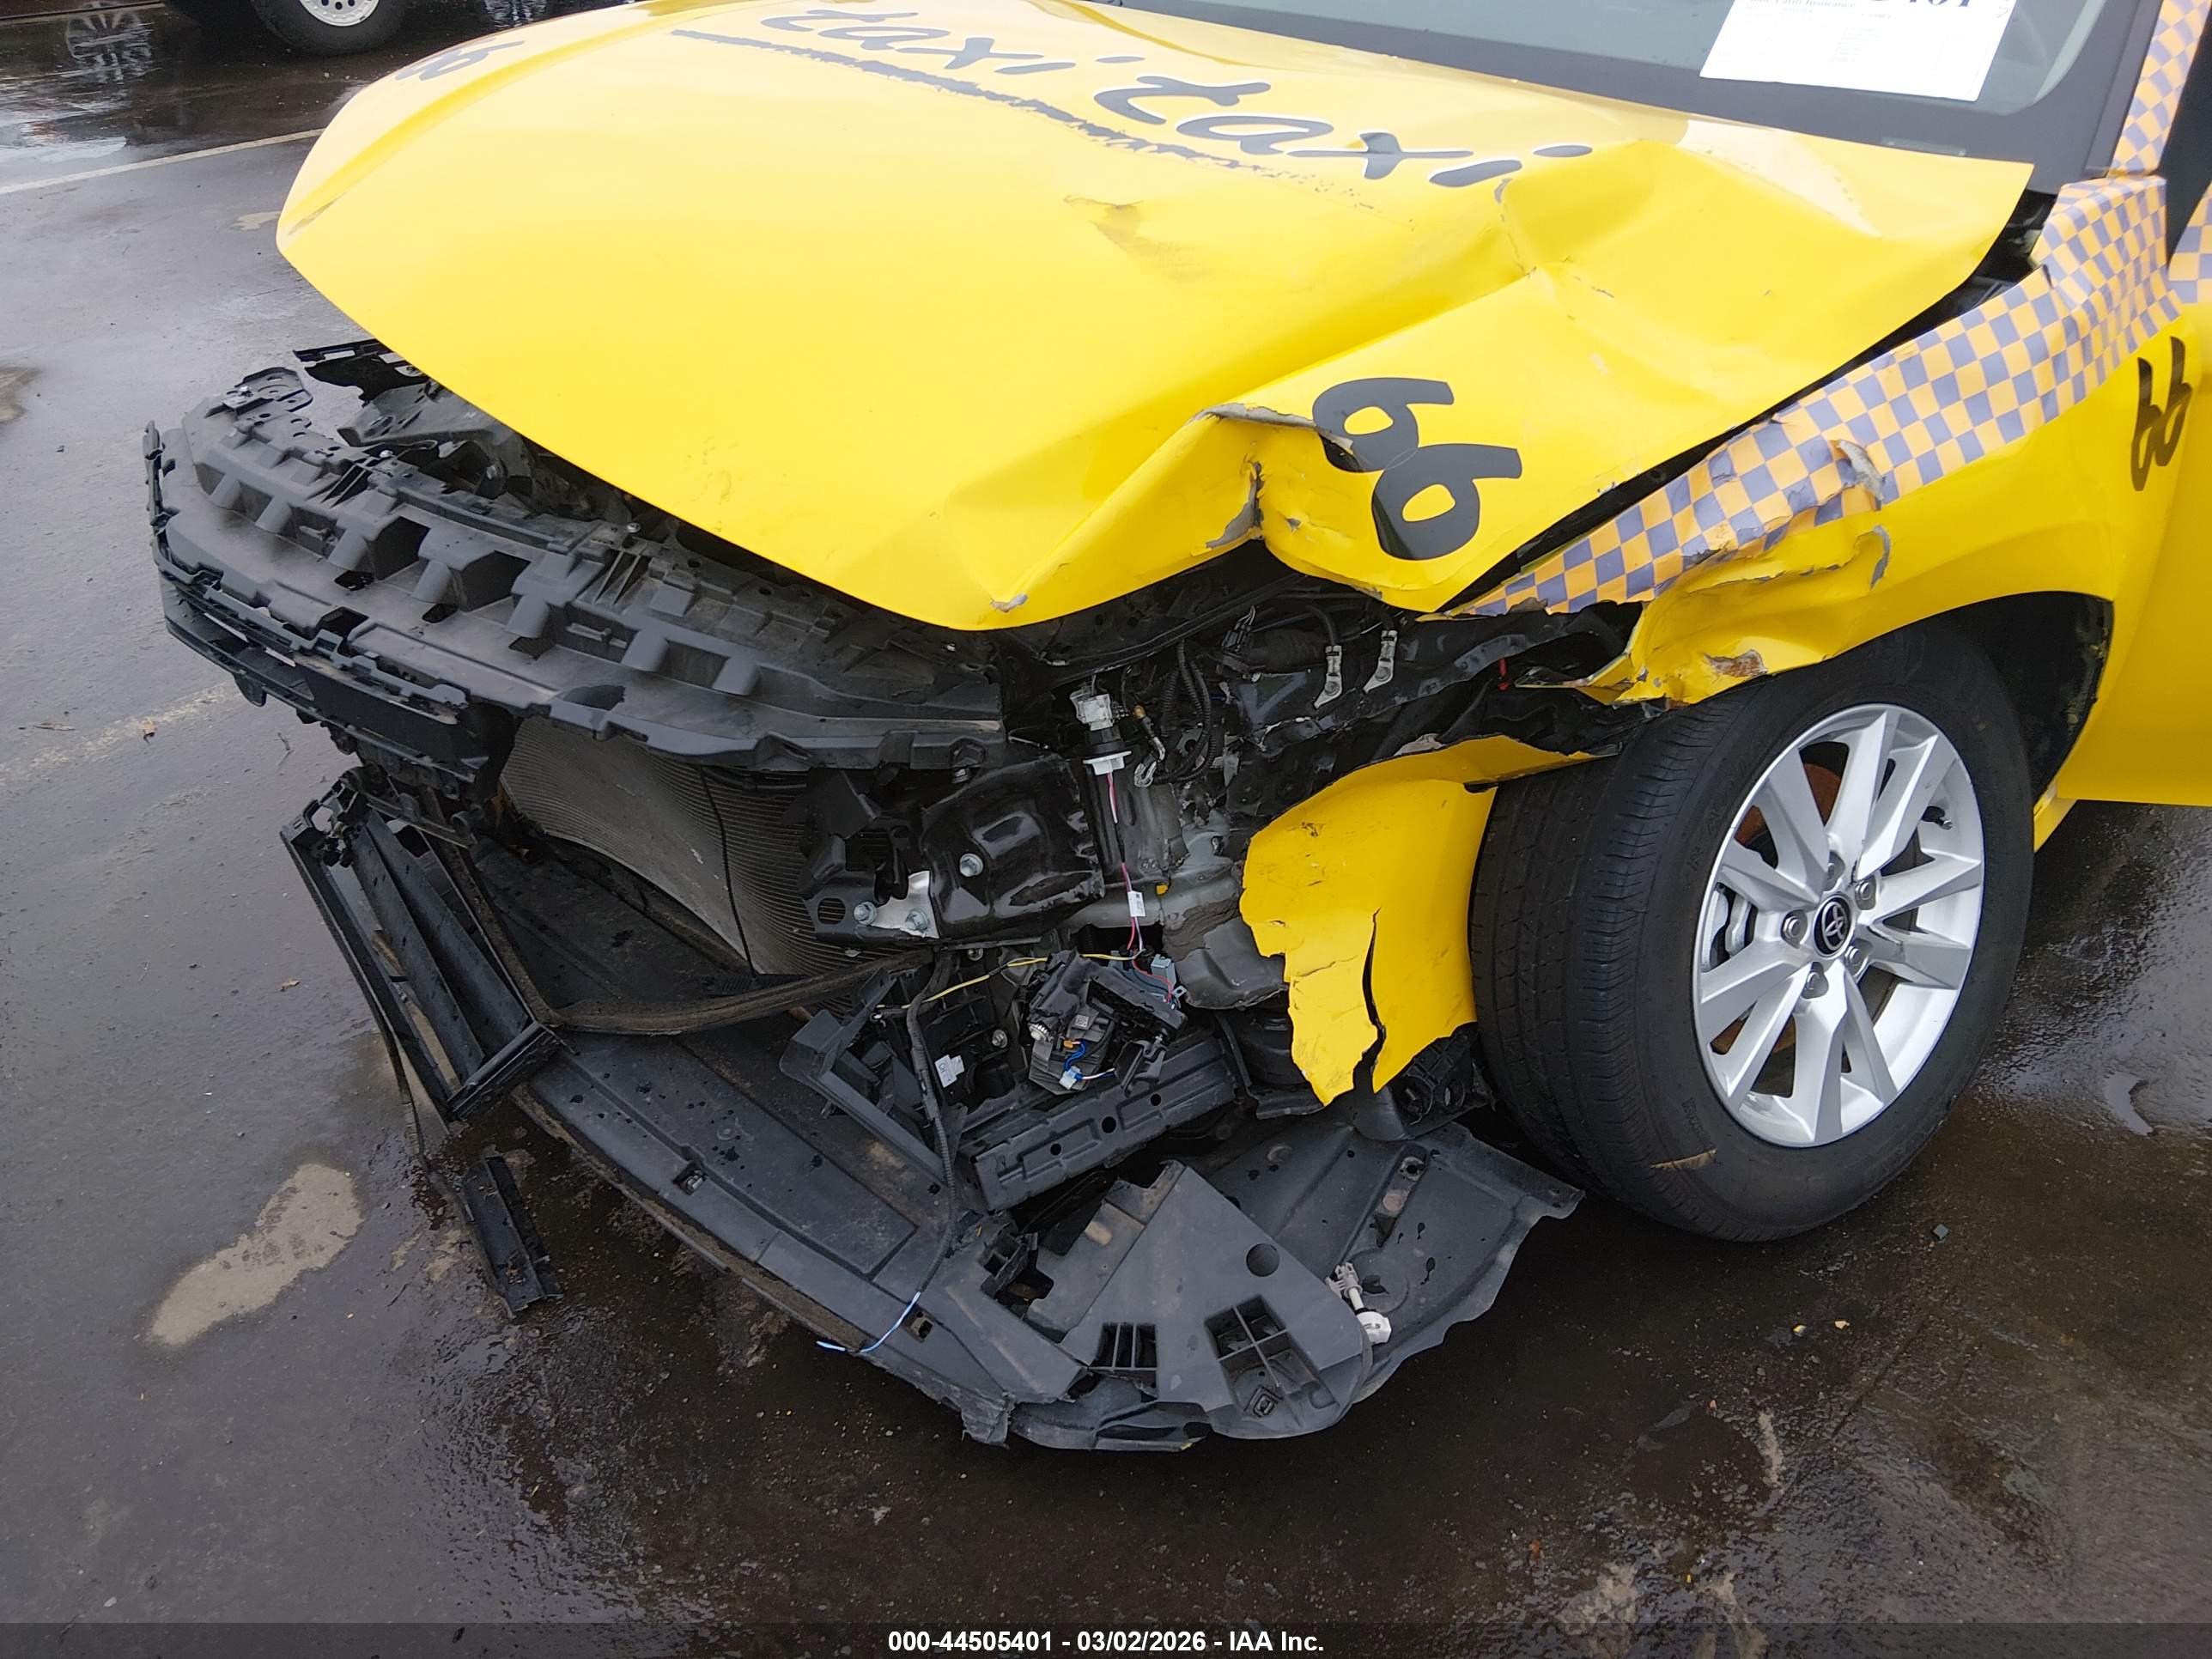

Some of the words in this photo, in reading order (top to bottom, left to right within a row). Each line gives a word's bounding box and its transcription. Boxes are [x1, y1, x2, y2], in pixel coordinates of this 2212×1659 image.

[760, 9, 1146, 76] taxi
[1093, 75, 1594, 189] taxi
[1311, 376, 1523, 561] 66
[2130, 335, 2194, 492] 66
